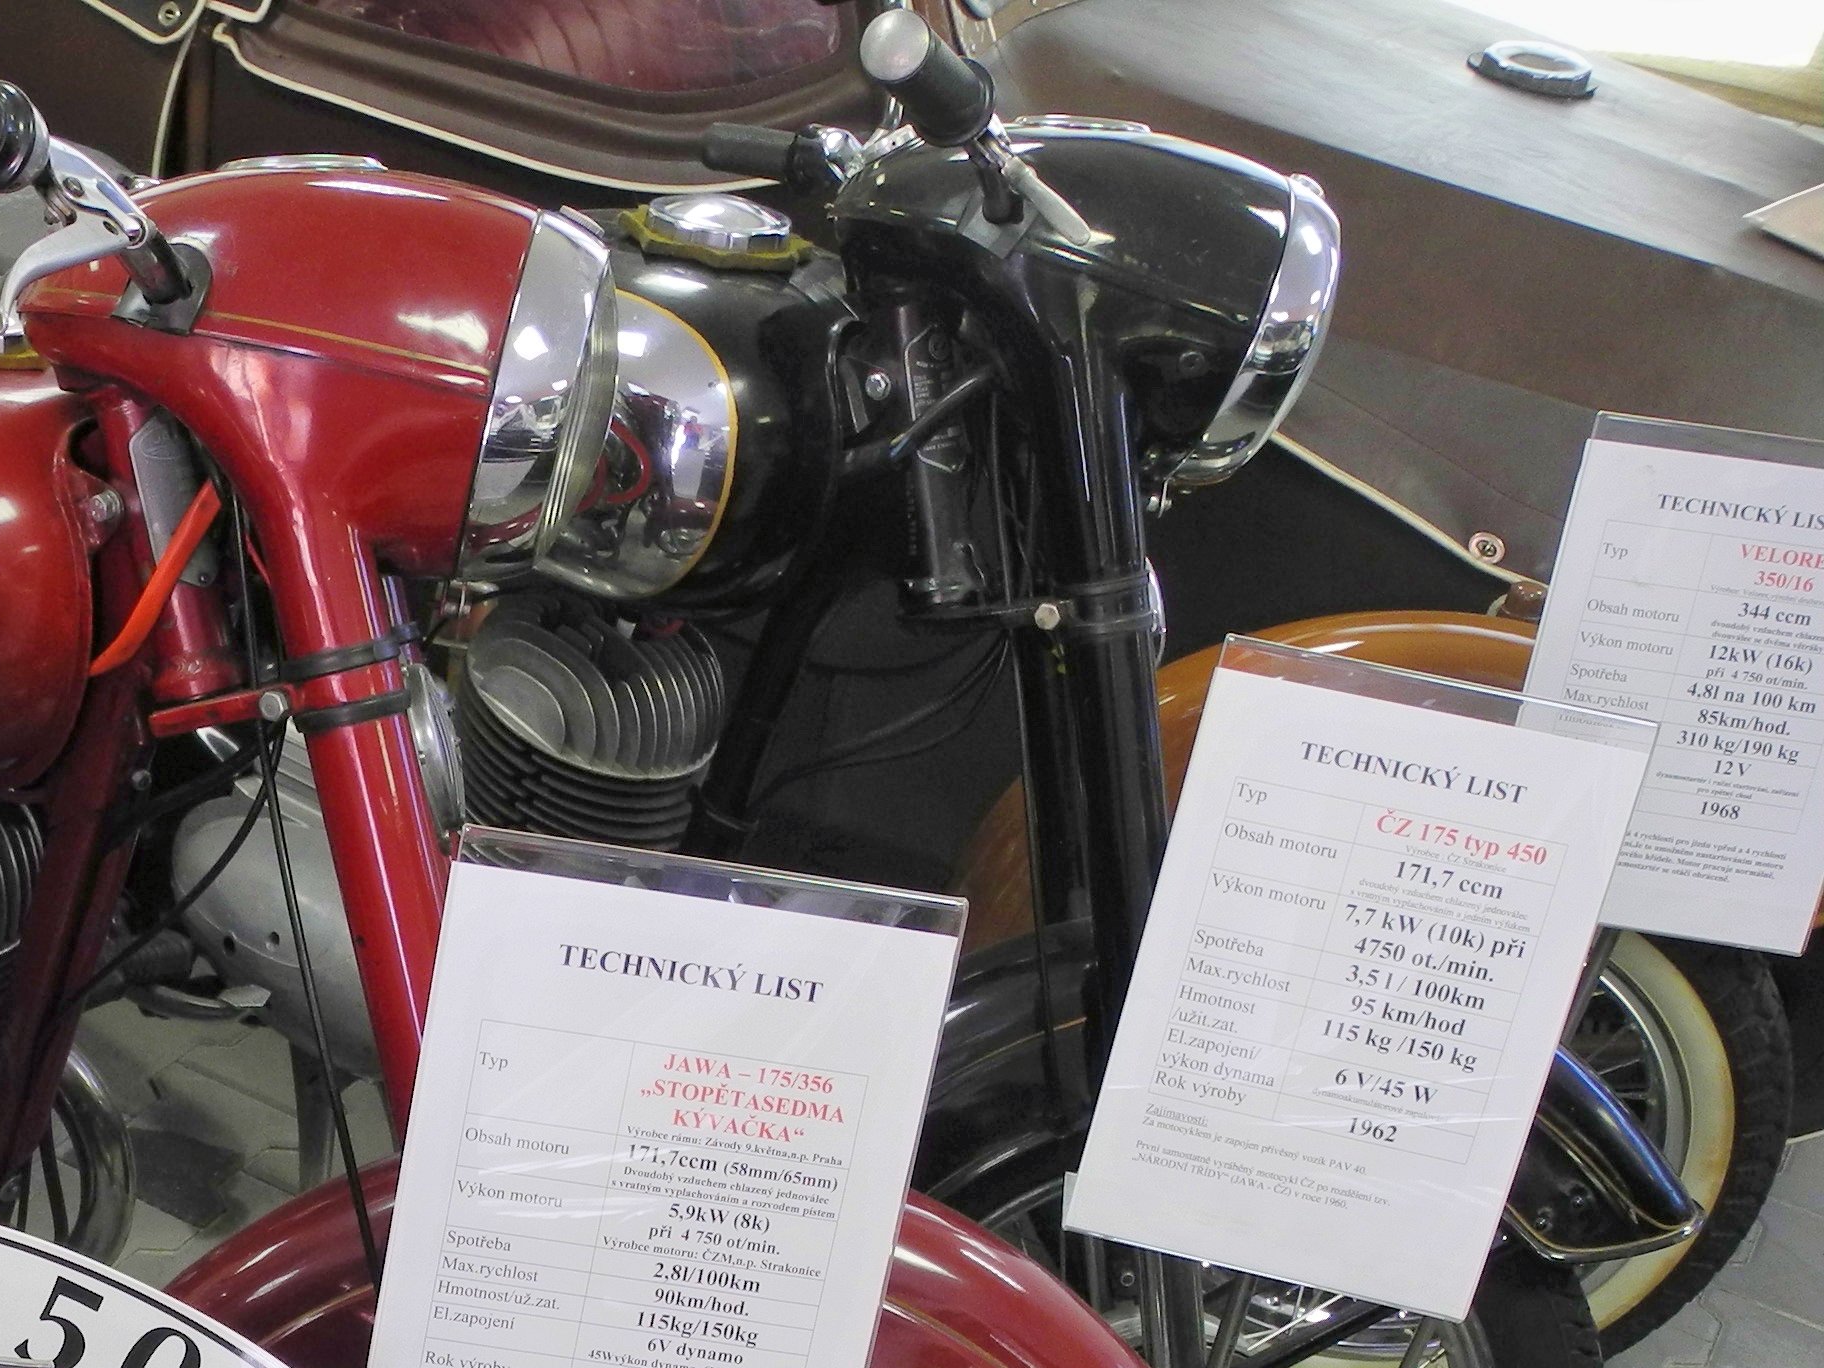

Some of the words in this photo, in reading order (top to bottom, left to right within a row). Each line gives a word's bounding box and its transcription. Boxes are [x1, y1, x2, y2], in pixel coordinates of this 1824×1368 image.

[1657, 493, 1789, 525] TECHNICKÝ
[1791, 511, 1824, 530] LIS
[1741, 543, 1824, 569] VELORE
[1753, 569, 1814, 593] 350/16
[1586, 598, 1629, 617] Obsah
[1631, 607, 1681, 623] motoru
[1737, 601, 1772, 621] 344
[1774, 611, 1812, 627] ccm
[1580, 630, 1623, 649] Výkon
[1625, 640, 1675, 656] motoru
[1569, 662, 1628, 683] Spotřeba
[1708, 644, 1760, 665] 12kW
[1765, 653, 1813, 676] (16k)
[1563, 687, 1650, 712] Max.rychlost
[1722, 690, 1746, 704] na
[1752, 690, 1784, 709] 100
[1786, 695, 1817, 714] km
[1696, 708, 1791, 737] 85km/hod.
[1675, 729, 1710, 748] 310
[1712, 734, 1774, 758] kg/190
[1776, 744, 1800, 766] kg
[1301, 741, 1462, 790] TECHNICKÝ
[1465, 775, 1529, 804] LIST
[1236, 781, 1268, 805] Typ
[1700, 800, 1742, 820] 1968
[1223, 822, 1275, 847] Obsah
[1278, 837, 1338, 860] motoru
[1376, 807, 1414, 839] ČZ
[1420, 823, 1460, 847] 175
[1463, 833, 1501, 861] typ
[1506, 841, 1548, 866] 450
[1212, 871, 1264, 898] Výkon
[1267, 888, 1327, 911] motoru
[1395, 860, 1455, 889] 171,7
[1458, 878, 1504, 900] ccm
[1193, 928, 1265, 958] Spotřeba
[1345, 903, 1378, 926] 7,7
[1380, 911, 1424, 935] kW
[1426, 922, 1485, 953] (10k)
[1489, 937, 1527, 959] při
[559, 943, 747, 992] TECHNICKÝ
[753, 972, 825, 1004] LIST
[1186, 956, 1291, 993] Max.rychlost
[1353, 936, 1406, 962] 4750
[1411, 953, 1494, 983] ot./min.
[1178, 984, 1256, 1015] Hmotnost
[1351, 995, 1377, 1016] 95
[1381, 1001, 1467, 1037] km/hod
[478, 1050, 509, 1072] Typ
[1322, 1019, 1361, 1043] 115
[1364, 1027, 1393, 1054] kg
[1449, 1046, 1478, 1073] kg
[663, 1053, 732, 1080] JAWA
[758, 1067, 834, 1095] 175/356
[1161, 1051, 1210, 1073] výkon
[1212, 1061, 1275, 1088] dynama
[1154, 1069, 1187, 1091] Rok
[1192, 1081, 1248, 1107] výroby
[1334, 1068, 1348, 1086] 6
[1413, 1084, 1439, 1105] W
[464, 1126, 512, 1148] Obsah
[515, 1138, 570, 1156] motoru
[1348, 1117, 1398, 1144] 1962
[630, 1143, 718, 1172] 171,7ccm
[722, 1161, 839, 1193] (58mm/65mm)
[456, 1178, 506, 1200] Výkon
[509, 1191, 563, 1209] motoru
[668, 1202, 730, 1225] 5,9kW
[733, 1212, 771, 1234] (8k)
[446, 1229, 512, 1252] Spotřeba
[647, 1224, 673, 1241] při
[680, 1228, 691, 1242] 4
[695, 1229, 723, 1247] 750
[725, 1237, 781, 1256] ot/min.
[441, 1255, 539, 1283] Max.rychlost
[603, 1235, 651, 1253] Výrobce
[759, 1259, 822, 1278] Strakonice
[432, 1305, 516, 1330] El.zapojení
[654, 1287, 749, 1317] 90km/hod.
[637, 1311, 758, 1347] 115kg/150kg
[424, 1350, 455, 1368] Rok
[647, 1338, 672, 1353] 6V
[675, 1342, 744, 1365] dynamo
